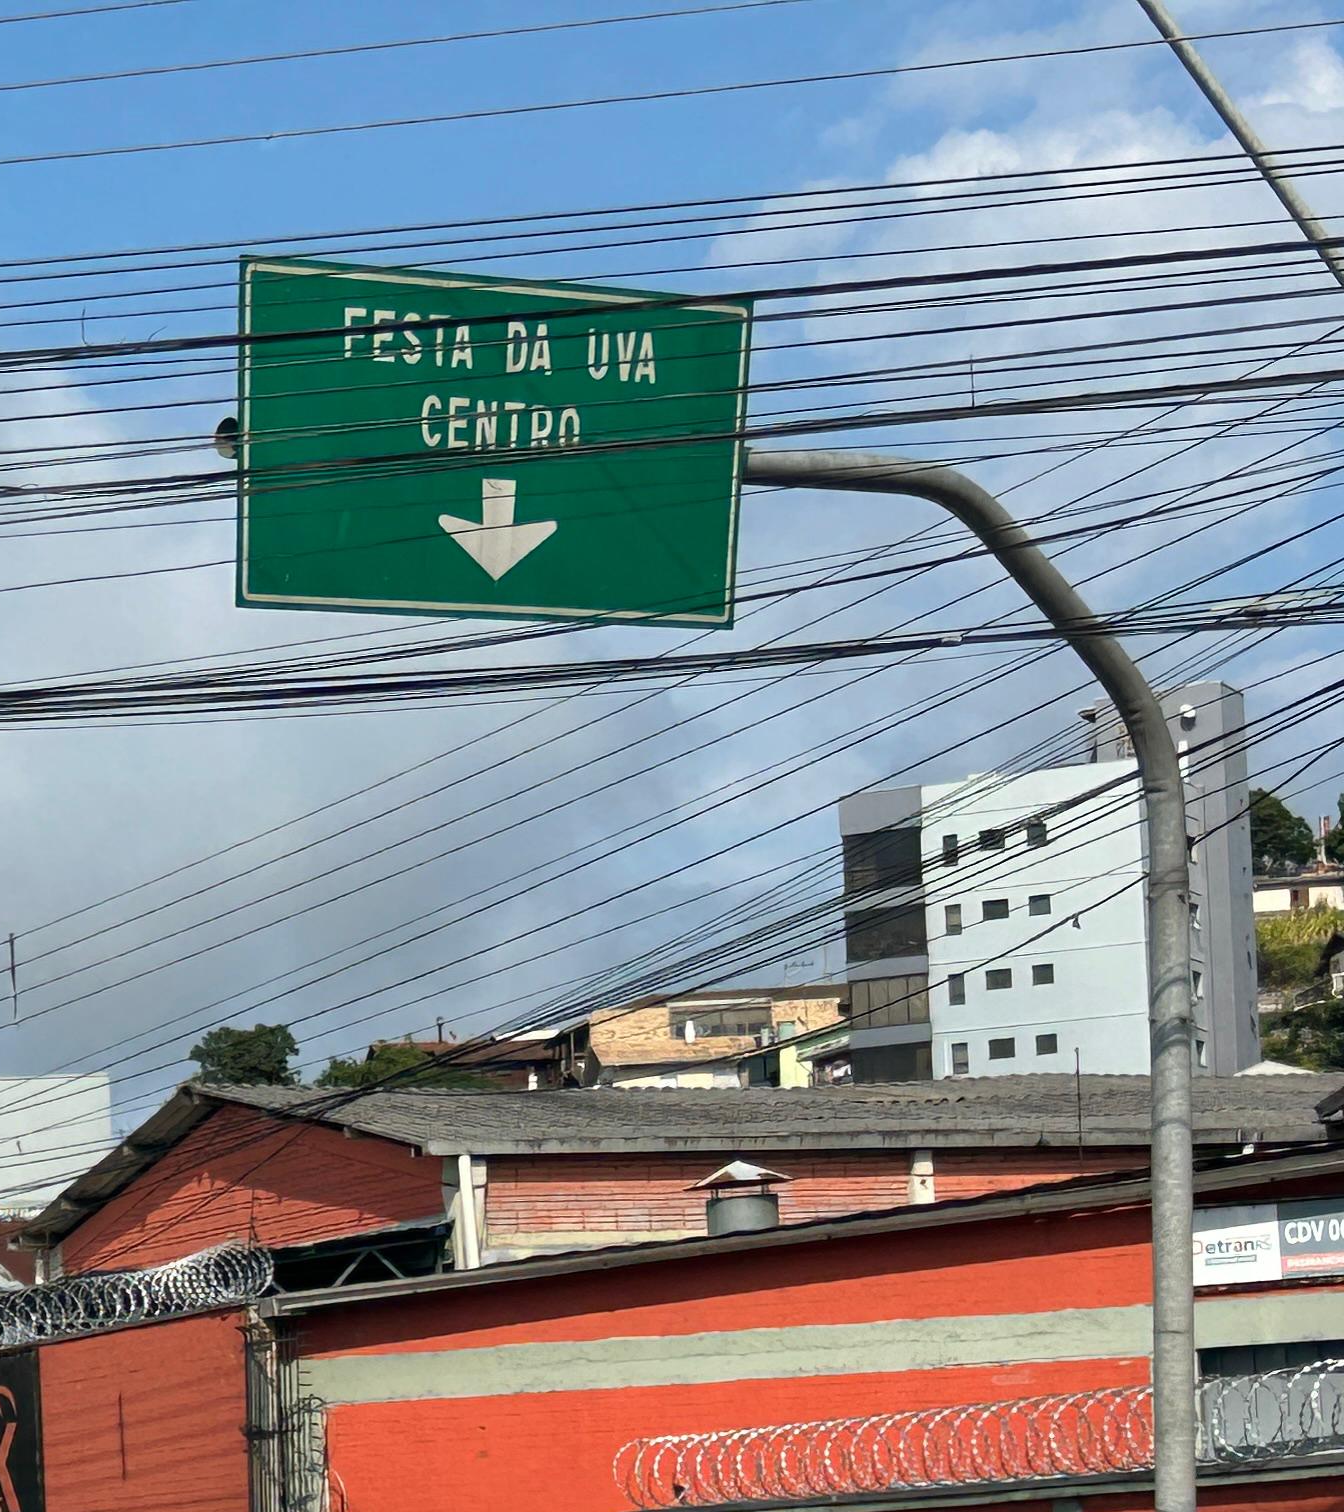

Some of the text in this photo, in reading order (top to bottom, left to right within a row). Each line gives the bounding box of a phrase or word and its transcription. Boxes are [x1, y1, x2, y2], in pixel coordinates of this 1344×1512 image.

[344, 306, 656, 384] FESTA DA UVA
[421, 394, 581, 452] CENTRO
[1284, 1219, 1324, 1244] CDV
